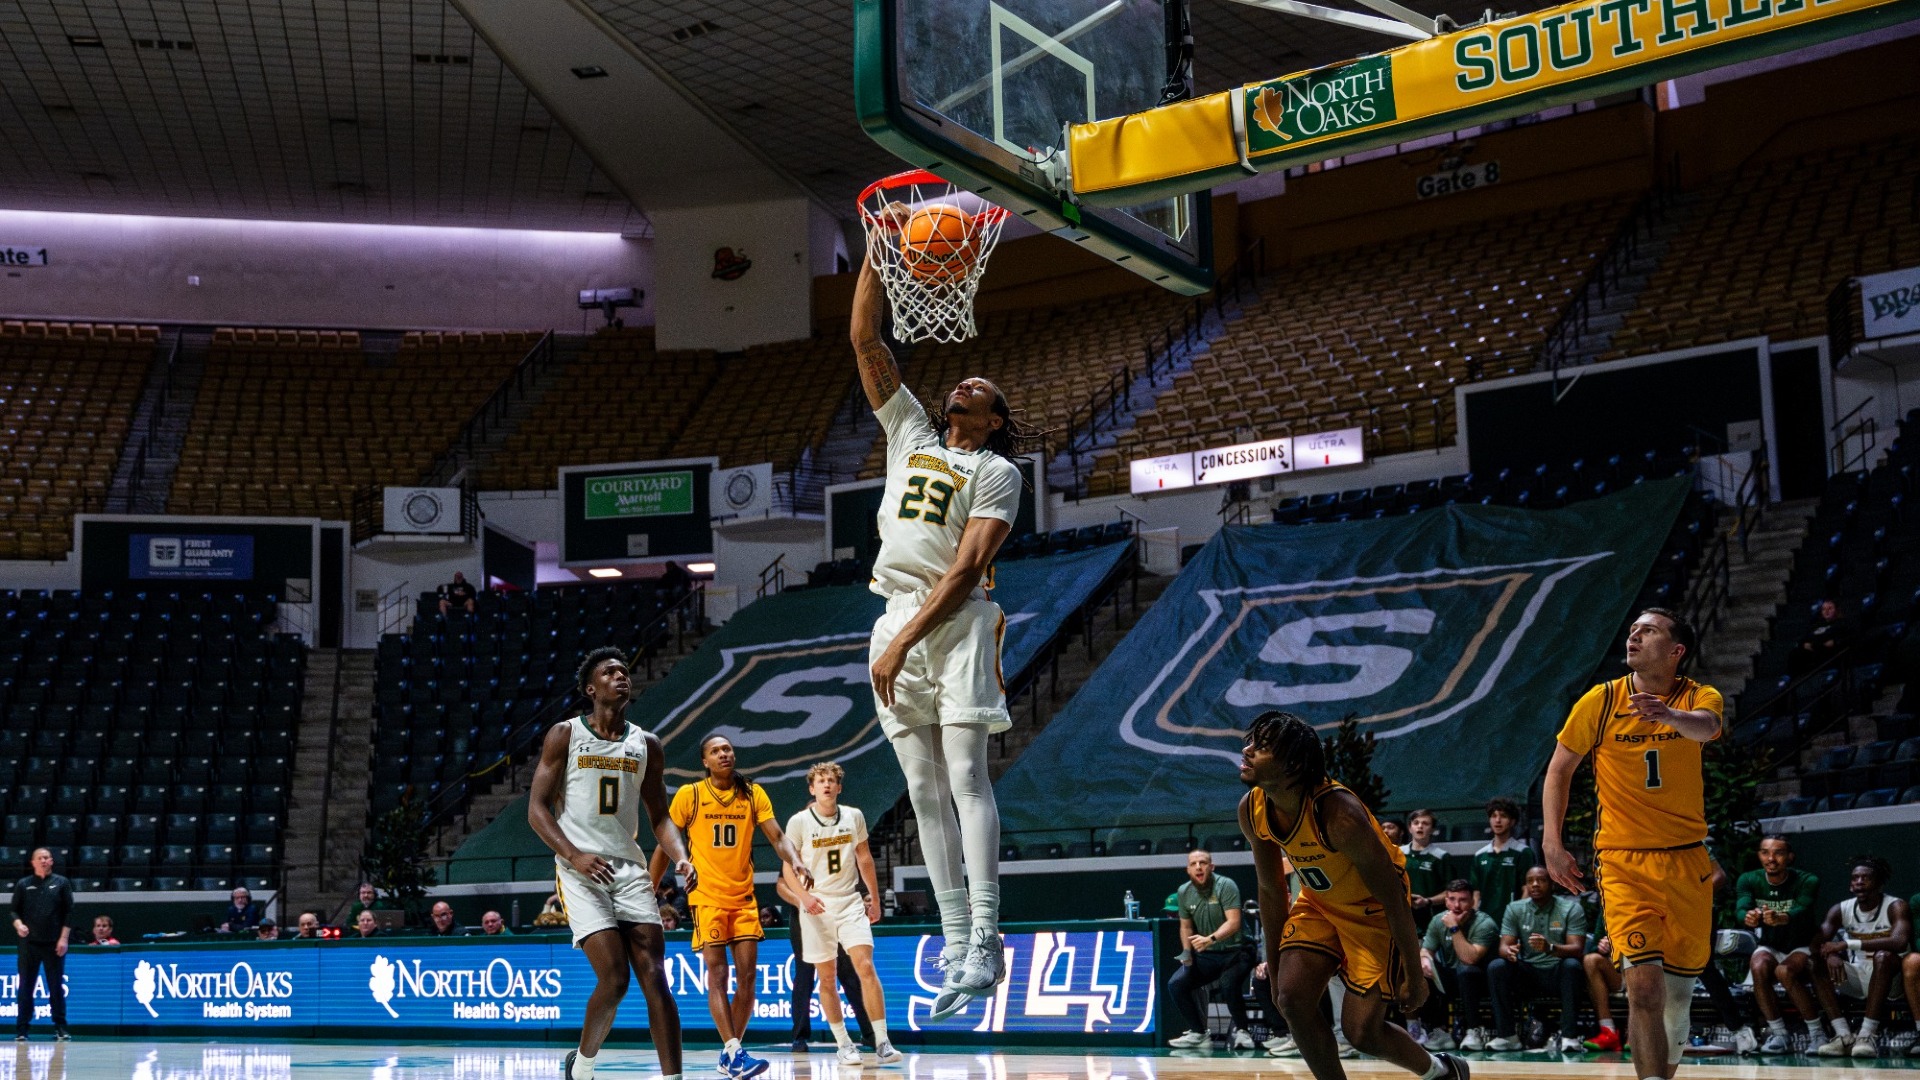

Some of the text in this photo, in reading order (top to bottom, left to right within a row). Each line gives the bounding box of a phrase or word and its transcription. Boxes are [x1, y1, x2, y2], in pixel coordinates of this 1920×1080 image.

[1284, 68, 1386, 113] NORTH
[1296, 98, 1376, 135] OAKS
[1418, 162, 1499, 197] Gate 8
[38, 248, 48, 265] 1
[1201, 444, 1286, 470] CONCESSIONS
[1307, 438, 1346, 451] ULTRA
[1144, 462, 1179, 476] ULTRA
[591, 477, 682, 494] COURTYARD
[898, 475, 956, 526] 23
[1224, 608, 1436, 707] S
[1615, 731, 1684, 743] EAST TEXA
[1644, 749, 1662, 789] 1
[598, 775, 620, 815] 0
[712, 822, 737, 849] 10
[828, 849, 842, 875] 8
[203, 1001, 292, 1021] Health System
[453, 1001, 561, 1022] Health System
